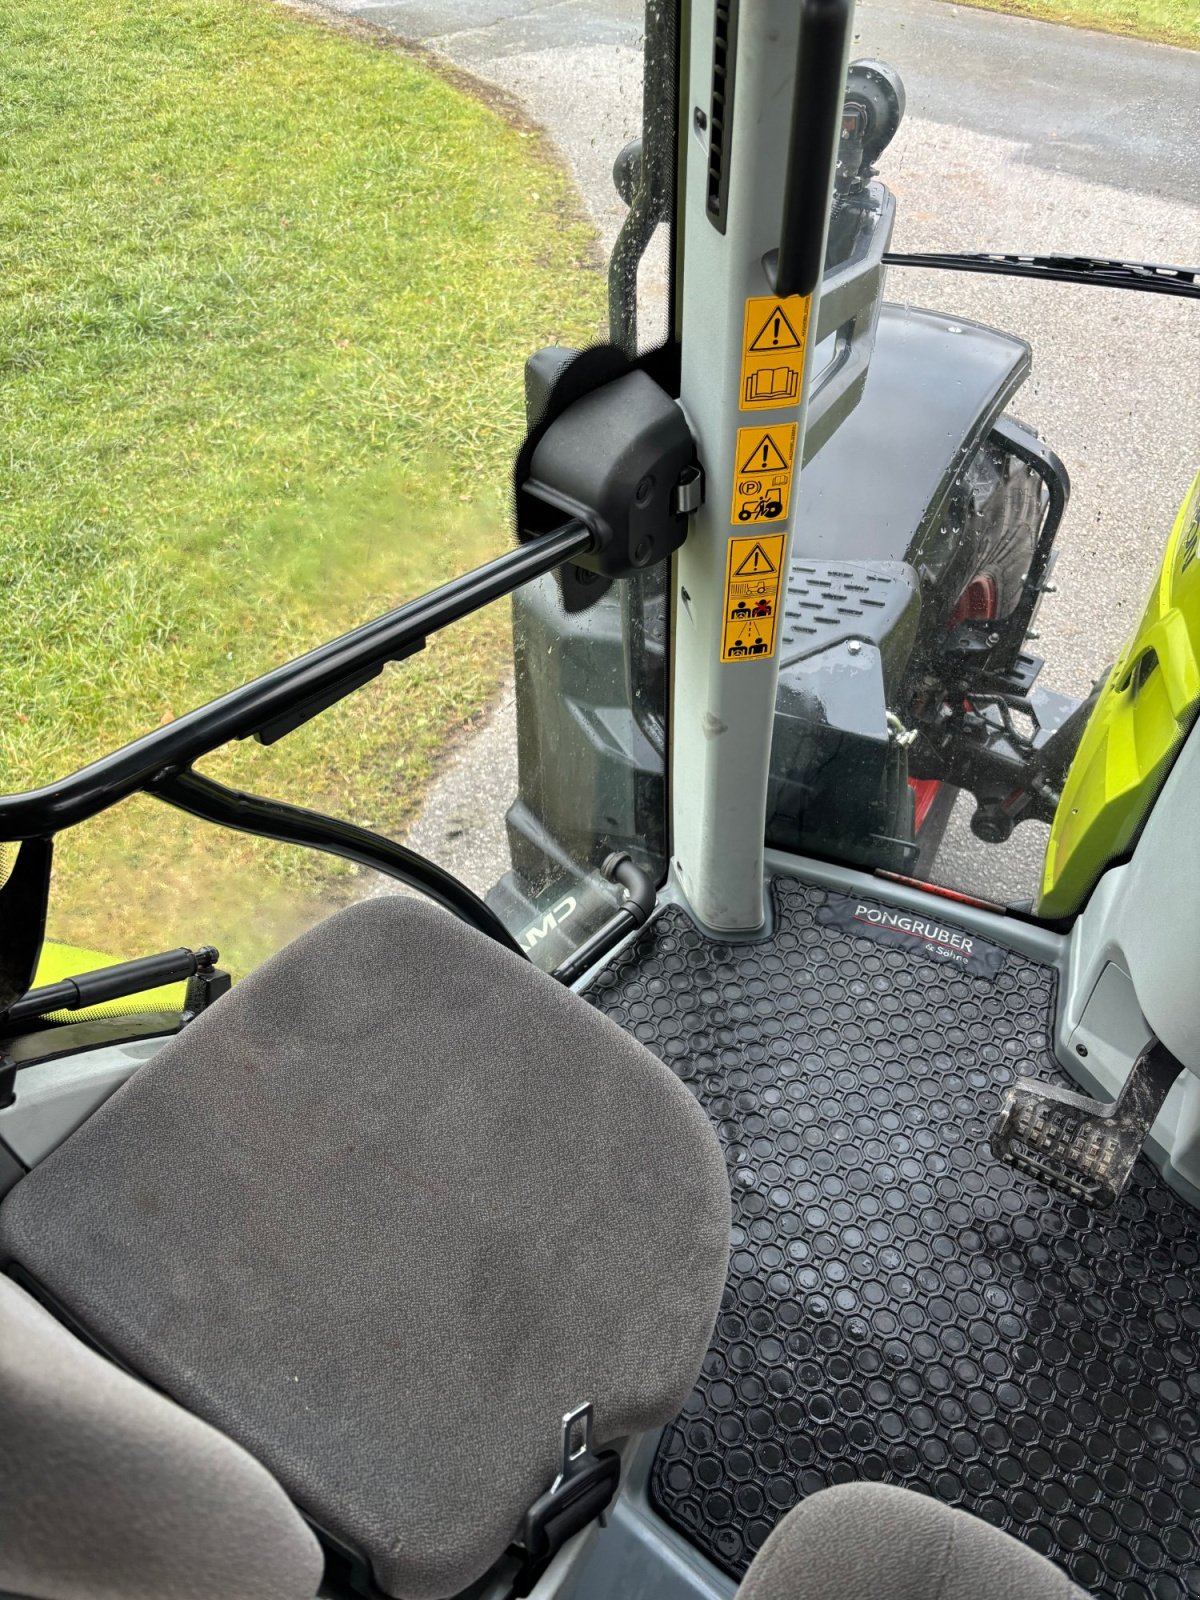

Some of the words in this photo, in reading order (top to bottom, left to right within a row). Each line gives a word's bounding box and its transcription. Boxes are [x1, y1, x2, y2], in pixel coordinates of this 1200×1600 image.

[855, 904, 974, 953] PONGRUBER
[925, 943, 935, 952] &
[936, 946, 969, 965] Söhne
